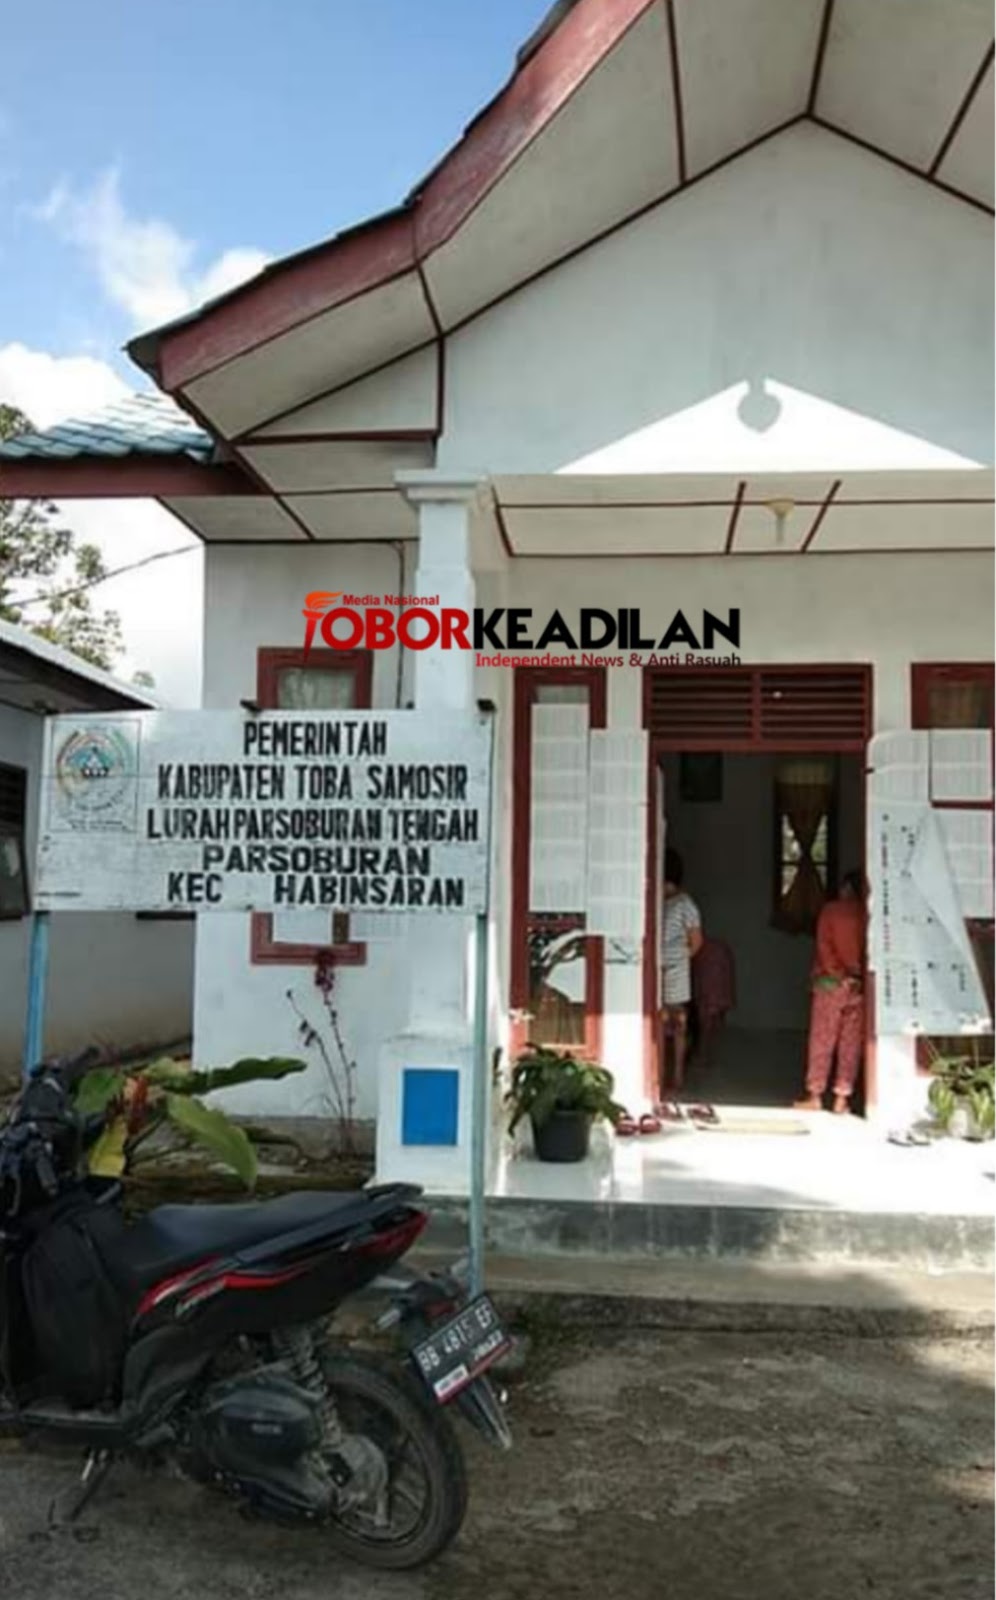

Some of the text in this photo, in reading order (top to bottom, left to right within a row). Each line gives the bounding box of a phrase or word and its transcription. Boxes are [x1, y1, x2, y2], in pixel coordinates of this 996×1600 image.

[243, 721, 387, 756] PEMERINTAH
[158, 764, 468, 800] KABUPATEN TOBA SAMOSIR
[388, 809, 479, 842] TENGAH
[202, 844, 431, 876] PARSOBURAN
[167, 872, 465, 906] KEC HABINSARAN
